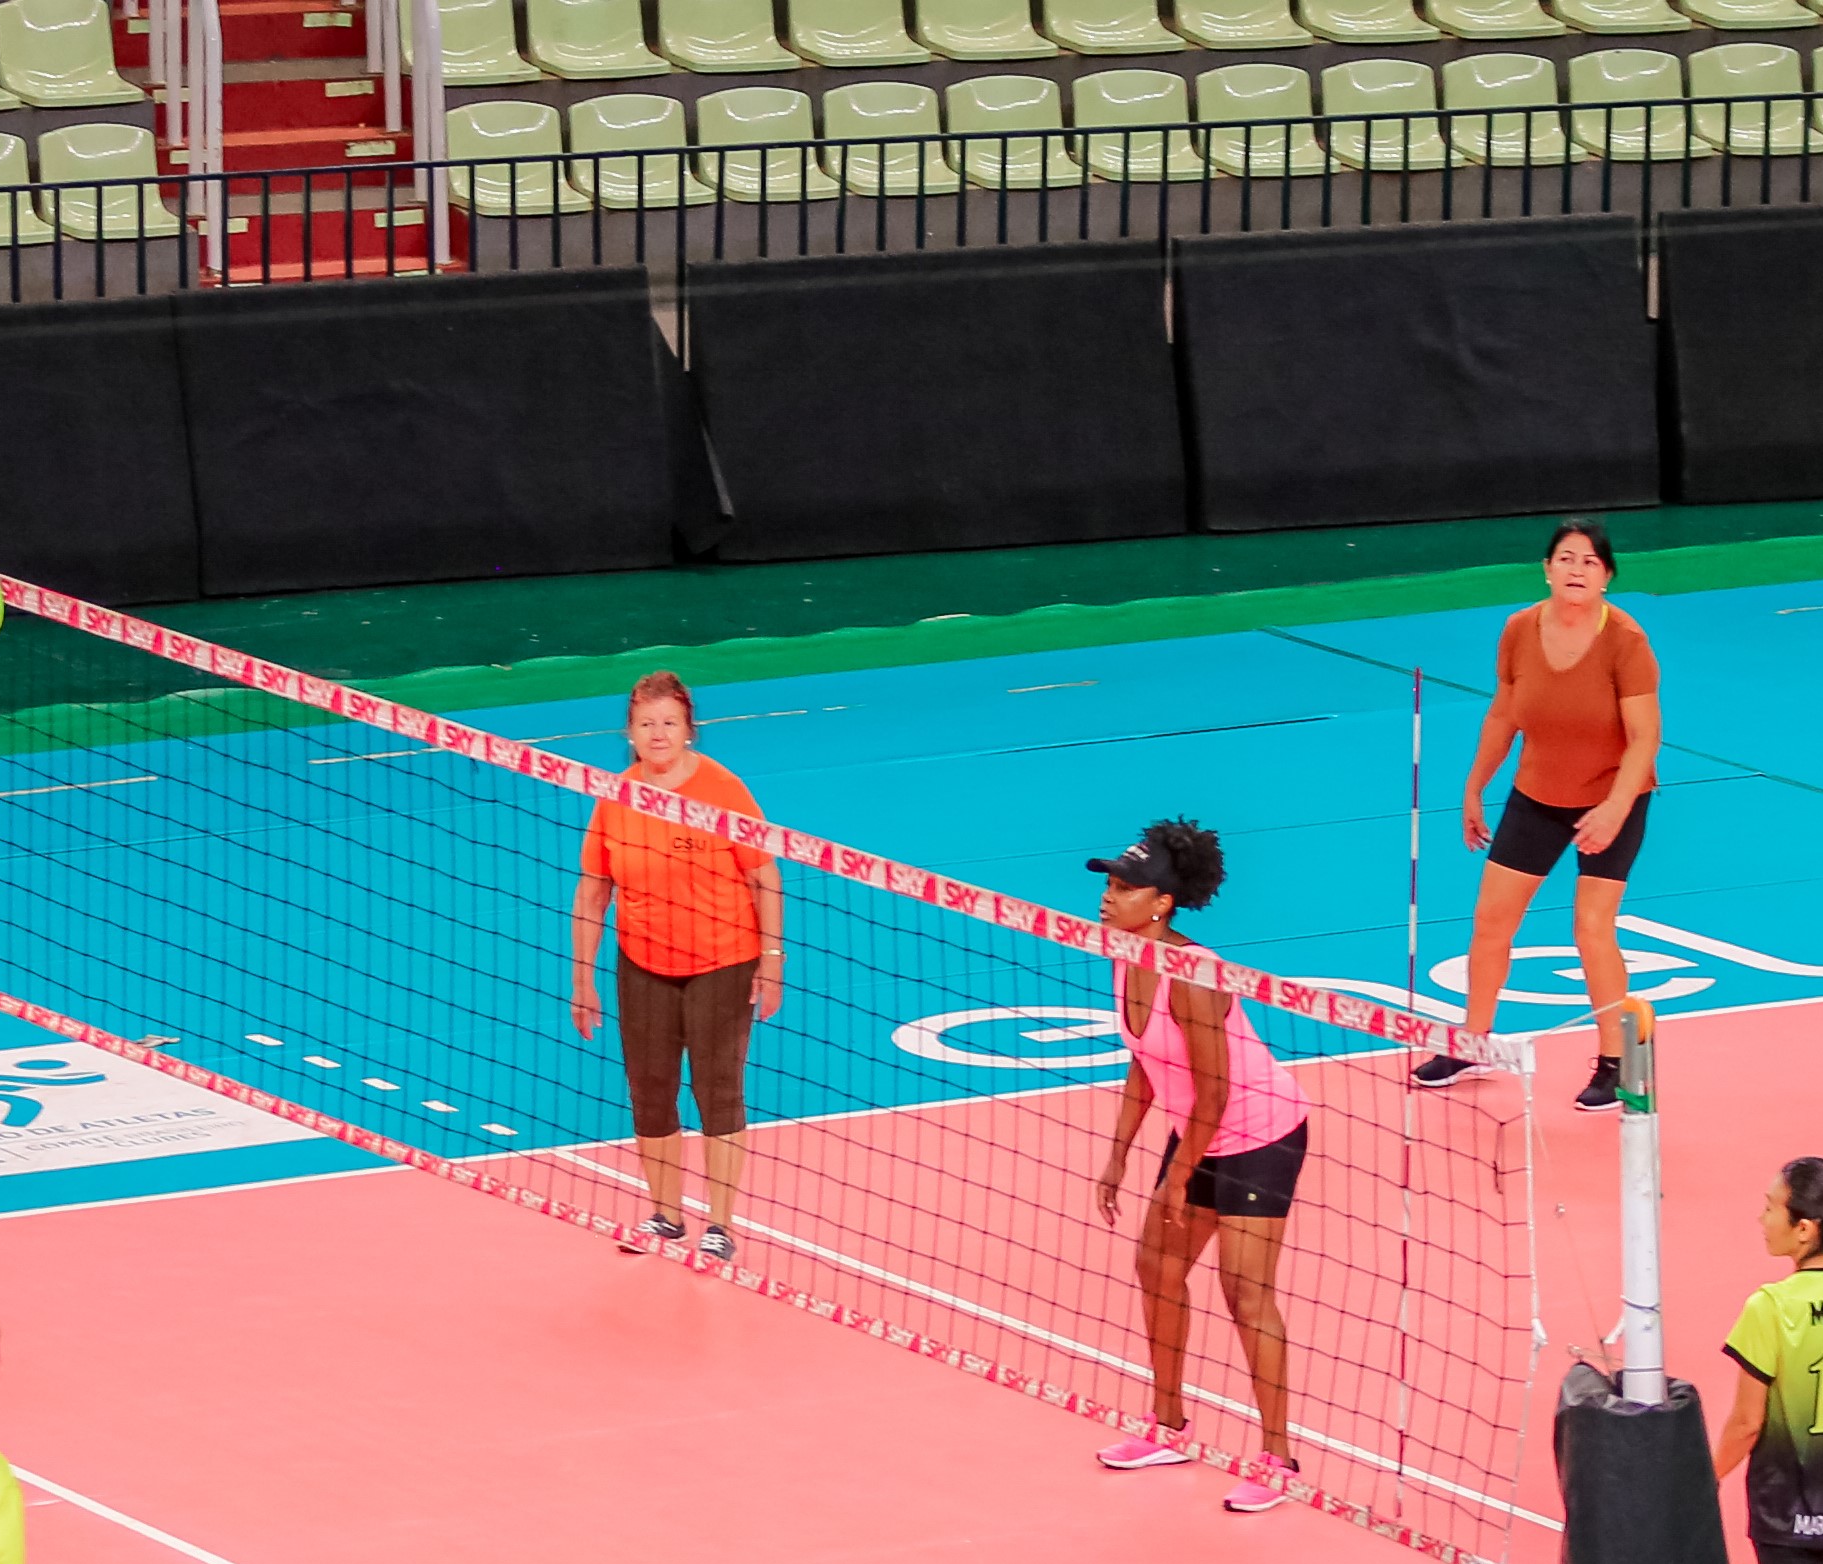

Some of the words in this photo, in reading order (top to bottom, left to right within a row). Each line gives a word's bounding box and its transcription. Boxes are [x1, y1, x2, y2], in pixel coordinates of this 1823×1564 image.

[83, 605, 108, 636] SKY
[170, 633, 196, 665] SKY
[260, 662, 289, 695] SKY
[300, 676, 331, 709] SKY
[348, 691, 377, 724] SKY
[395, 706, 426, 740] SKY
[443, 722, 474, 755] SKY
[488, 736, 521, 771] SKY
[538, 752, 571, 787] SKY
[587, 768, 620, 802] SKY
[635, 783, 672, 819] SKY
[684, 798, 719, 834] SKY
[736, 815, 773, 851] SKY
[787, 831, 824, 867] SKY
[839, 847, 877, 884] SKY
[887, 862, 926, 899] SKY
[940, 879, 979, 916] SKY
[997, 896, 1037, 933] SKY
[1055, 914, 1097, 952] SKY
[1105, 929, 1146, 966] SKY
[1163, 946, 1202, 983] SKY
[1218, 962, 1256, 998] SKY
[1277, 979, 1316, 1015] SKY
[1333, 995, 1373, 1031] SKY
[1394, 1011, 1433, 1047] SKY
